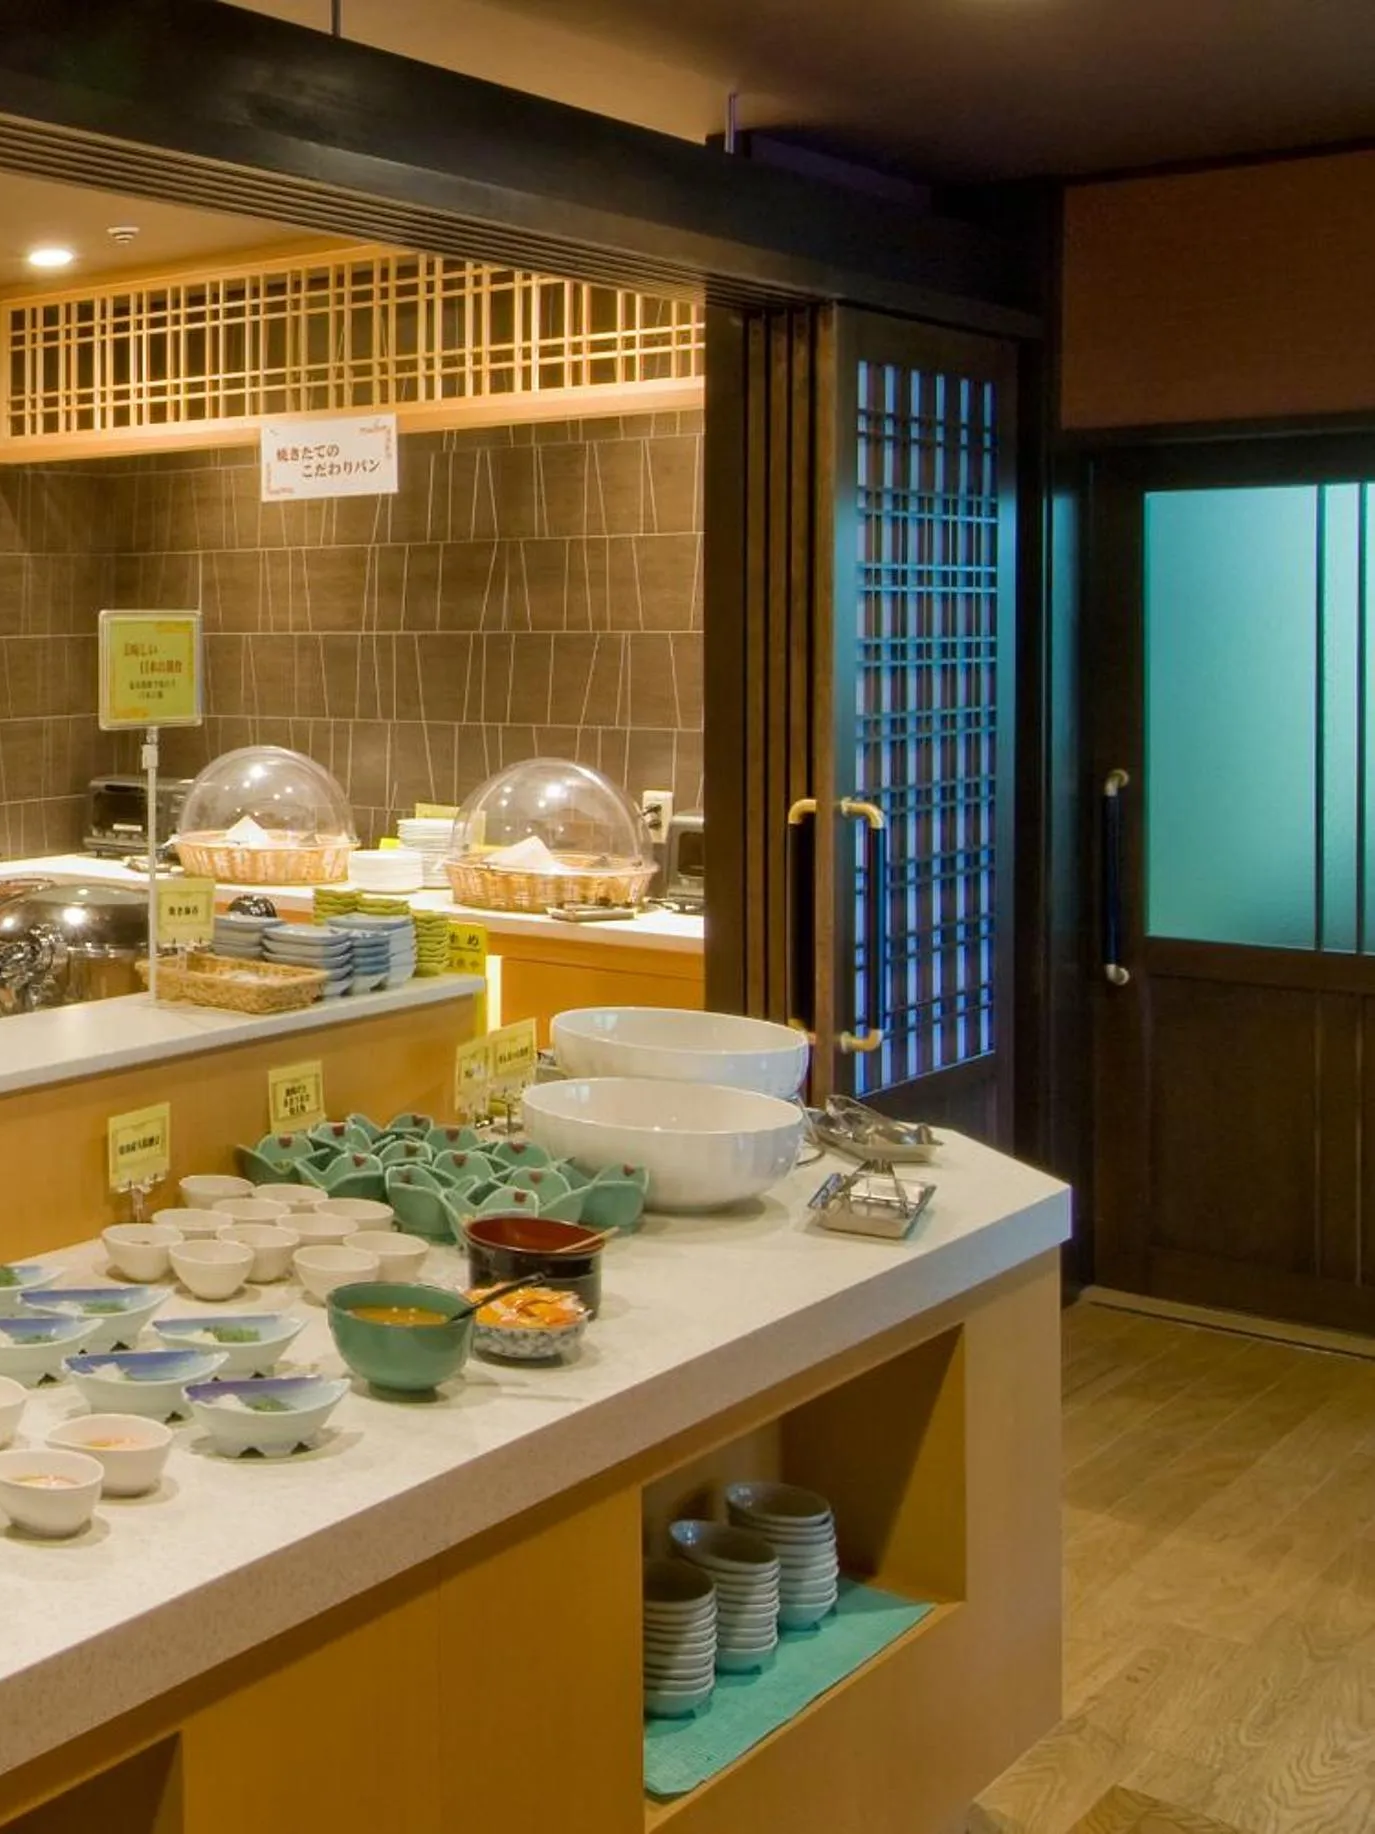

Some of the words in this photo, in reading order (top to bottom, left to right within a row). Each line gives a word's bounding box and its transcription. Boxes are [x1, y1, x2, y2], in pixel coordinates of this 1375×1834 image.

[276, 444, 340, 462] 焼きたての
[302, 460, 381, 479] こだわりパン
